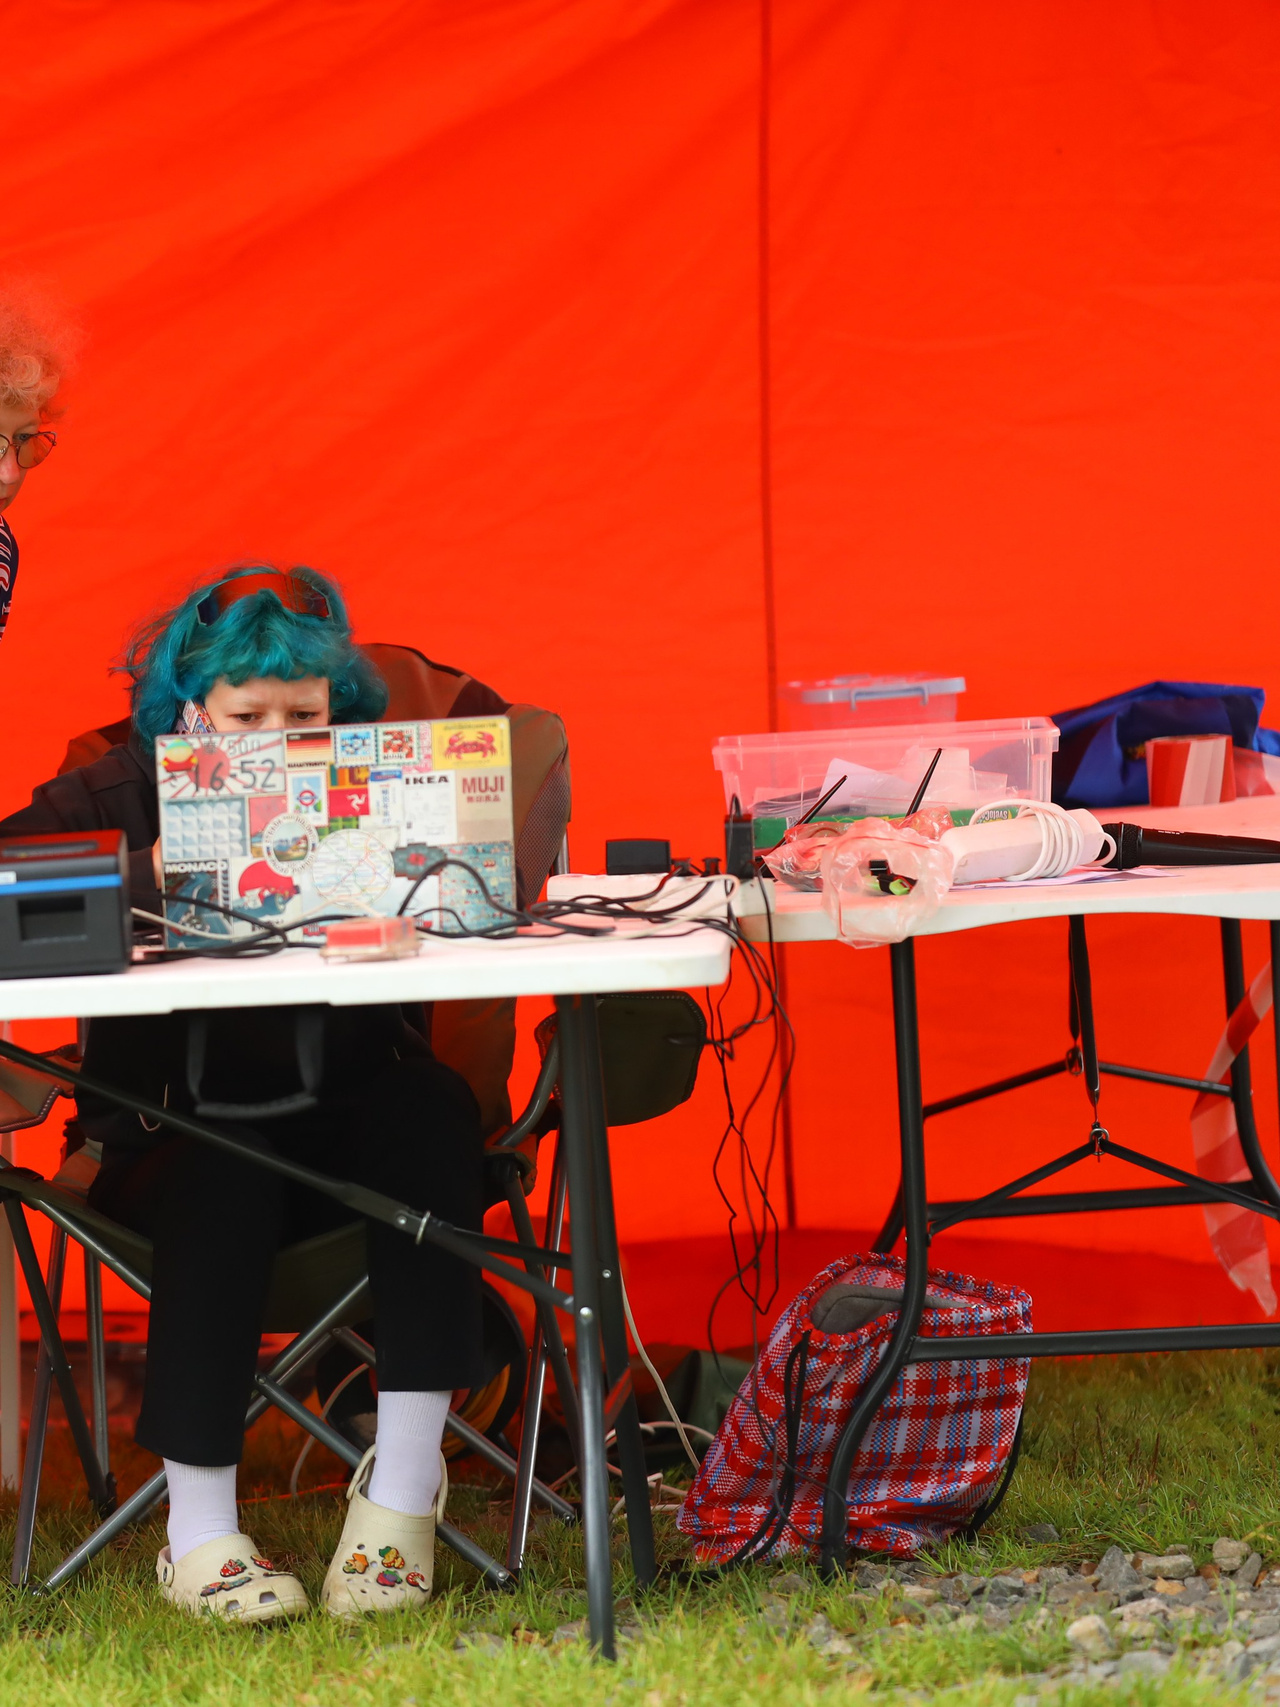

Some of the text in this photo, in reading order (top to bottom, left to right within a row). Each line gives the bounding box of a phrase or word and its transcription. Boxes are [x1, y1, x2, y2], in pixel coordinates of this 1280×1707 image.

[405, 775, 449, 786] IKEA
[462, 775, 505, 794] MUJI
[164, 861, 229, 874] MONACO
